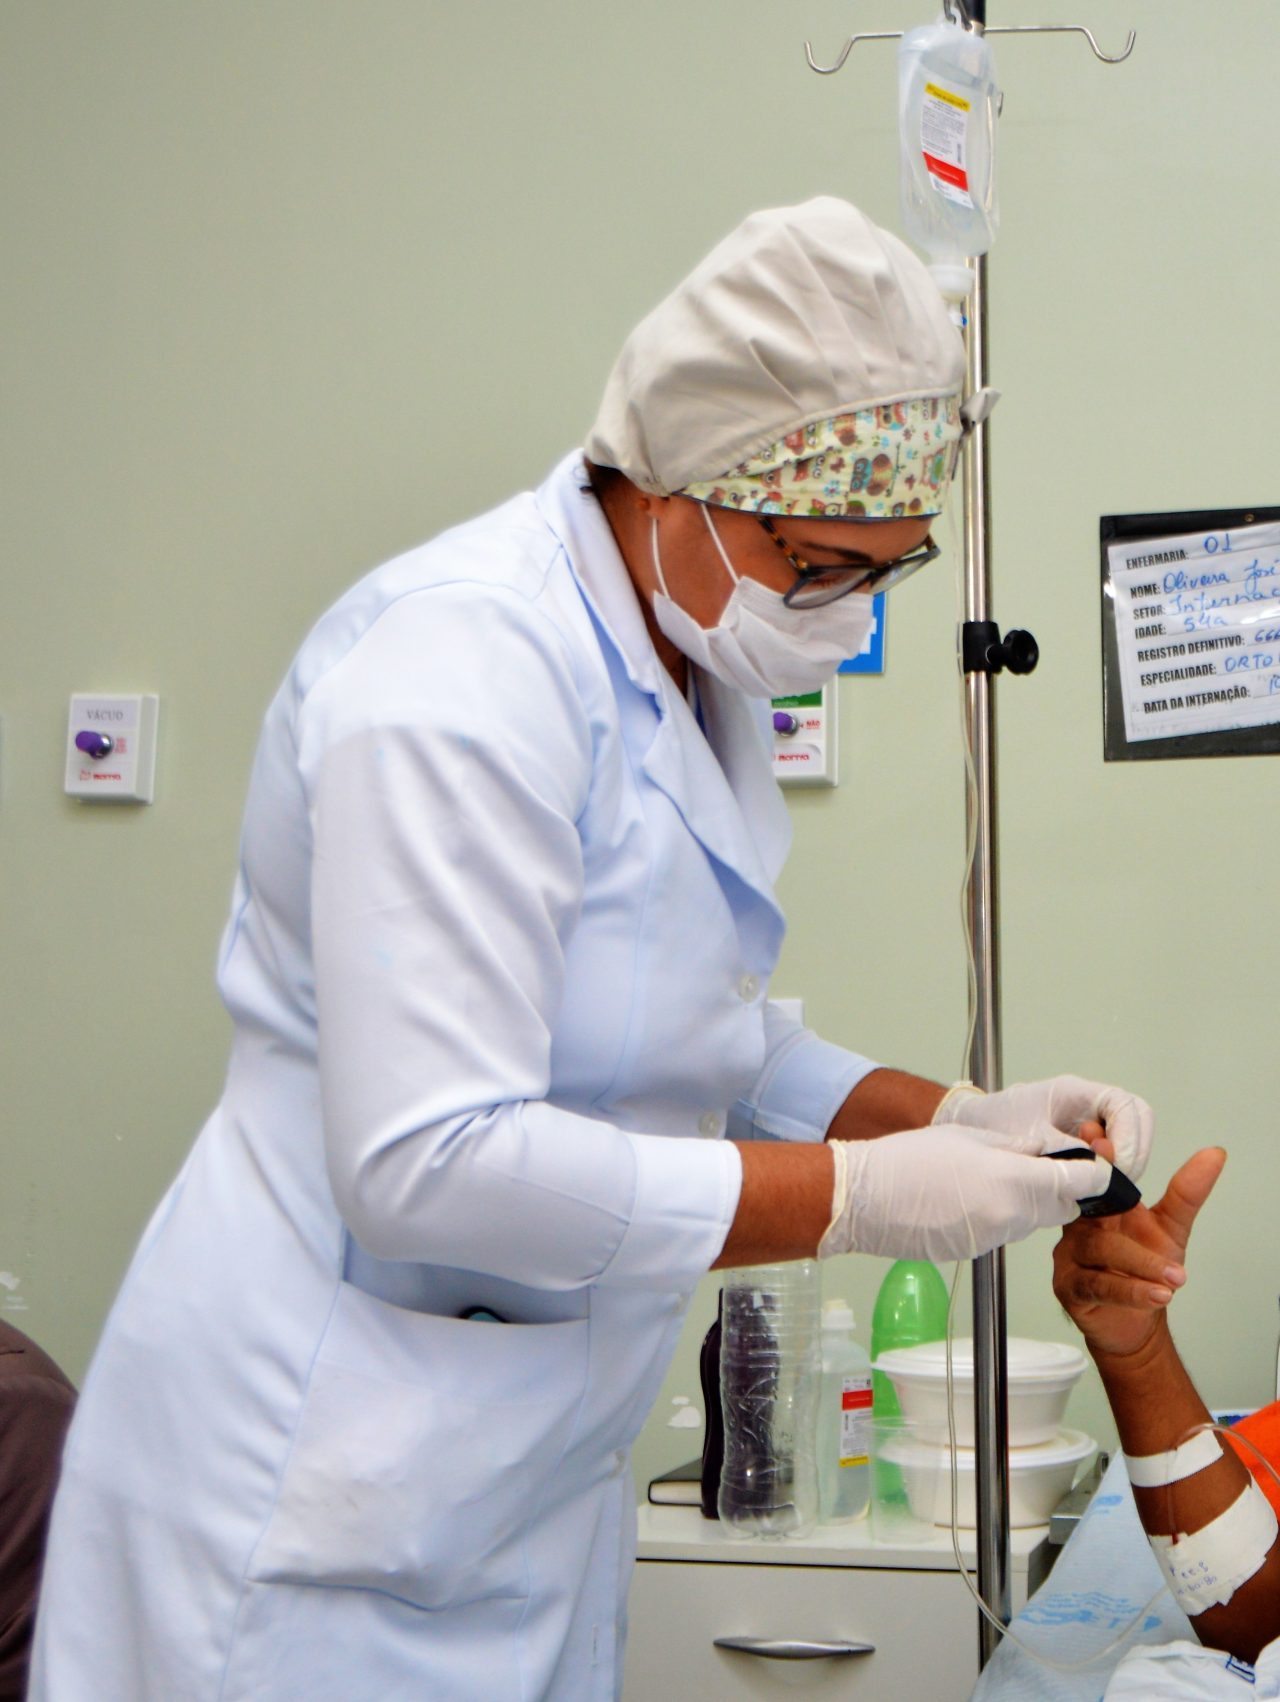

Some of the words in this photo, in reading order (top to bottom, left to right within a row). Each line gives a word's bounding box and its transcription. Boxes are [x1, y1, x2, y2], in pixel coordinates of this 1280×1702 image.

[1126, 549, 1189, 570] ENFERMARIA:
[1204, 533, 1232, 554] 01
[1130, 583, 1161, 599] NOME:
[1133, 604, 1165, 620] SETOR:
[1135, 623, 1166, 639] IDADE:
[1137, 644, 1186, 663] REGISTRO
[1188, 635, 1245, 655] DEFINITIVO:
[1140, 663, 1217, 686] ESPECIALIDADE:
[1144, 699, 1169, 714] DATA
[1170, 697, 1184, 711] DA
[1185, 685, 1251, 707] INTERNAÇÃO:
